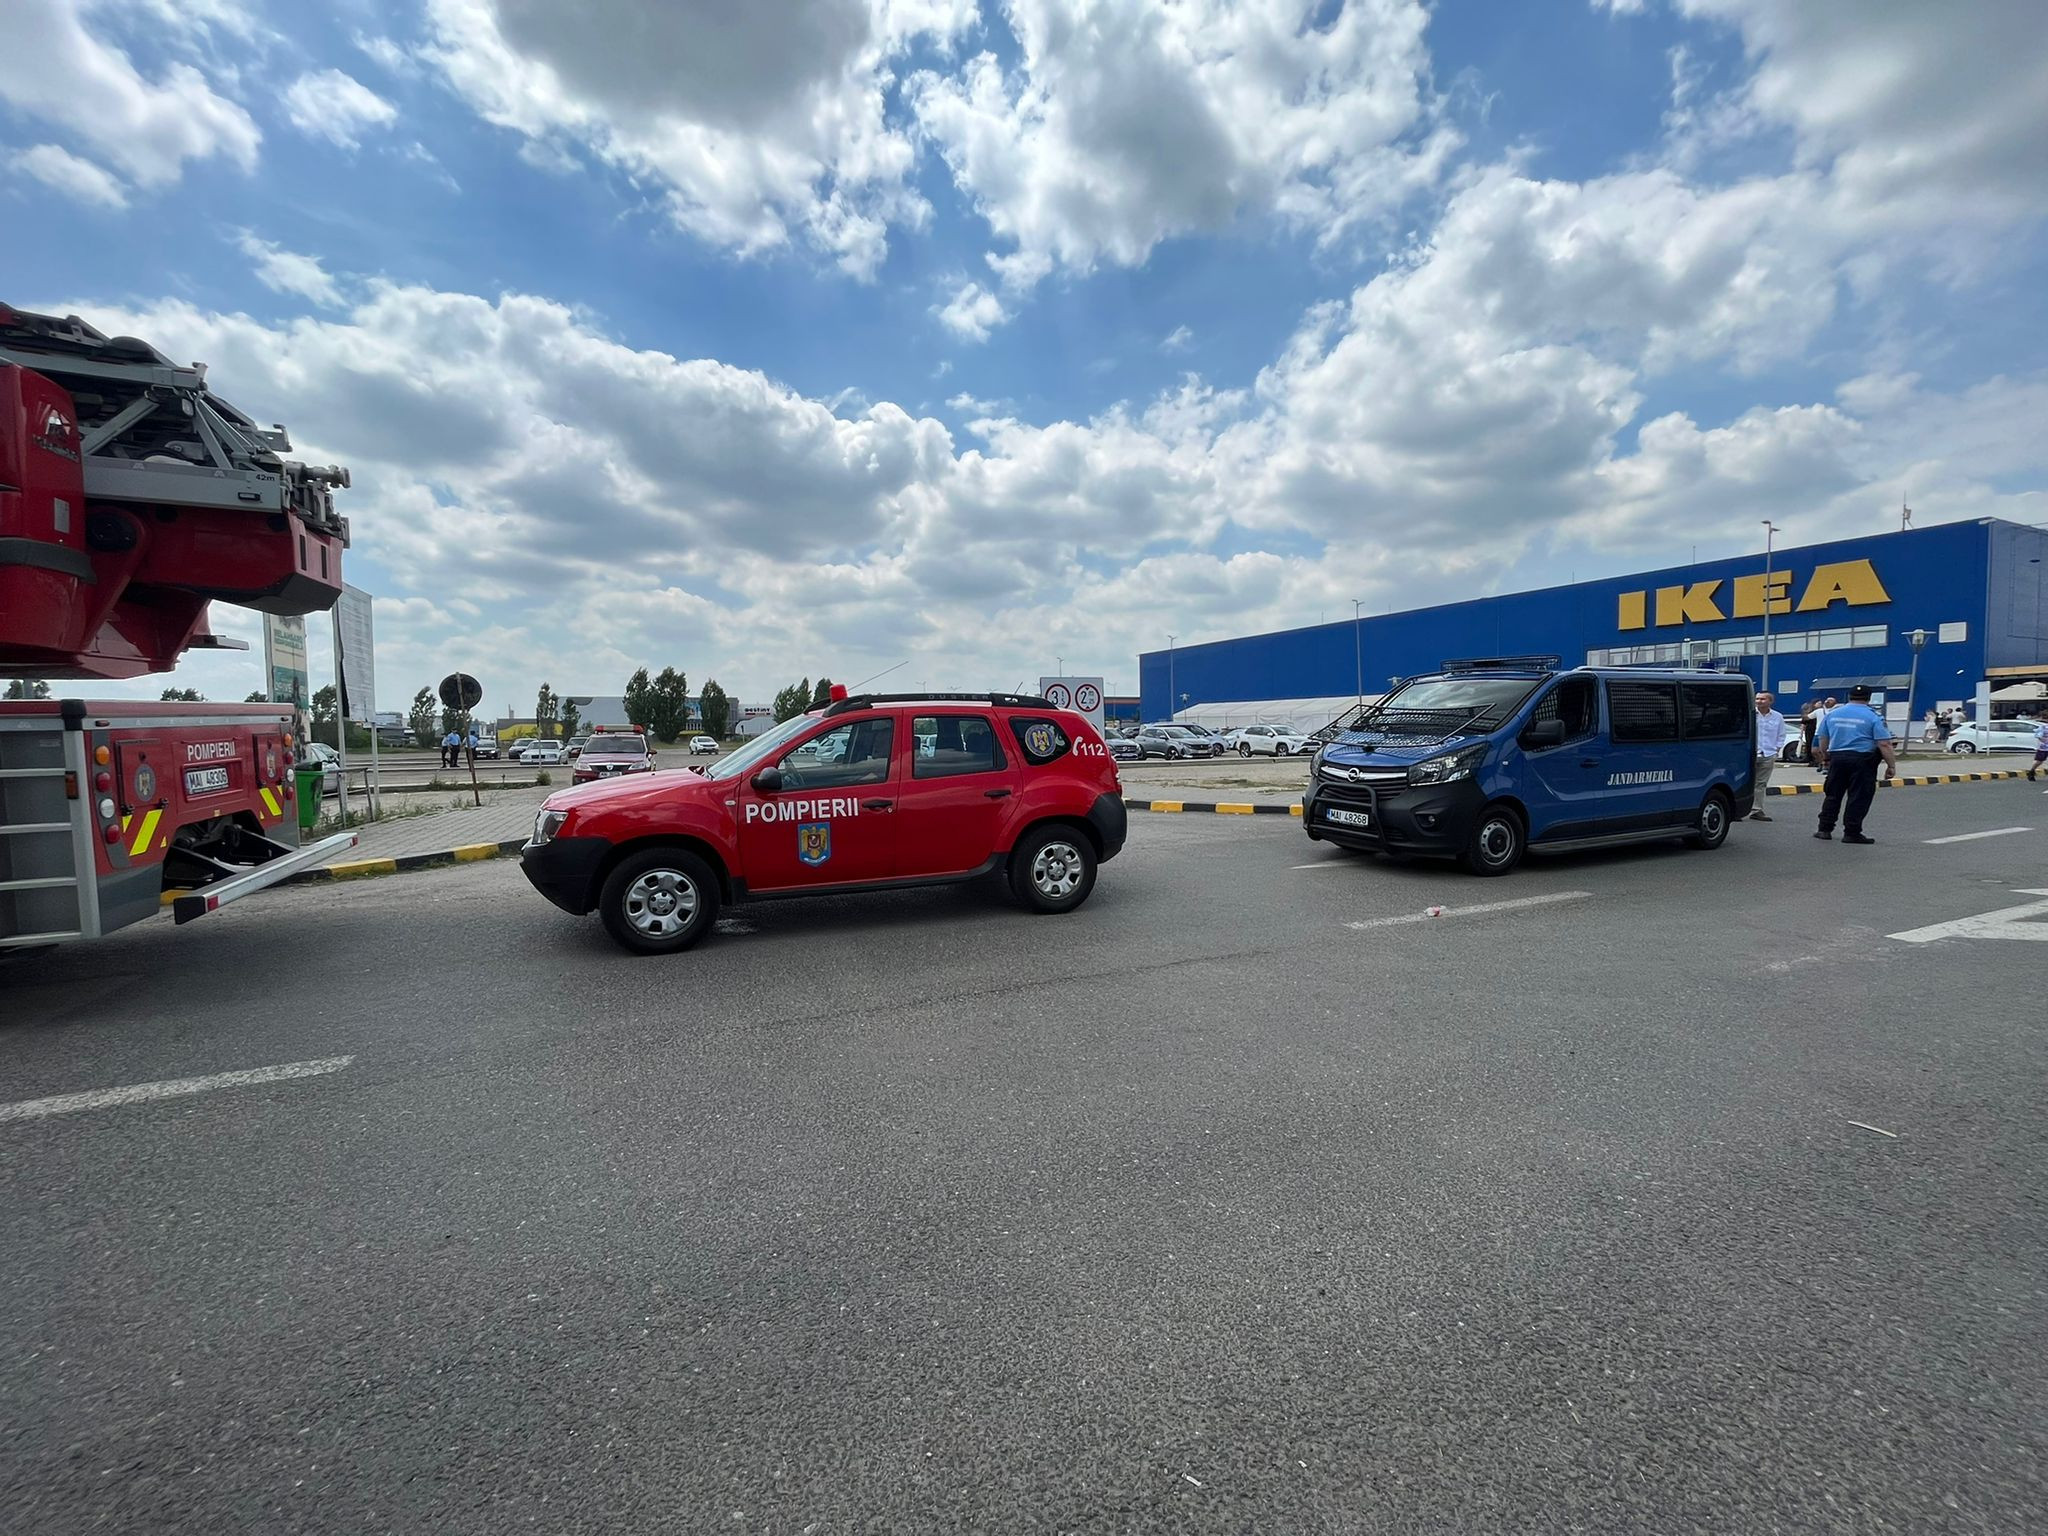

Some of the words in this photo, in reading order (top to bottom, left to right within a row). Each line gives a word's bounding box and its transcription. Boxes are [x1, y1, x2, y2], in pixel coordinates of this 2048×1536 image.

[1618, 559, 1892, 631] IKEA
[187, 741, 236, 761] POMPIERII
[1081, 743, 1105, 756] 112
[189, 772, 203, 788] MAI
[1607, 769, 1673, 786] JANDARMERIA
[745, 797, 859, 824] POMPIERII
[1331, 810, 1342, 820] MAI
